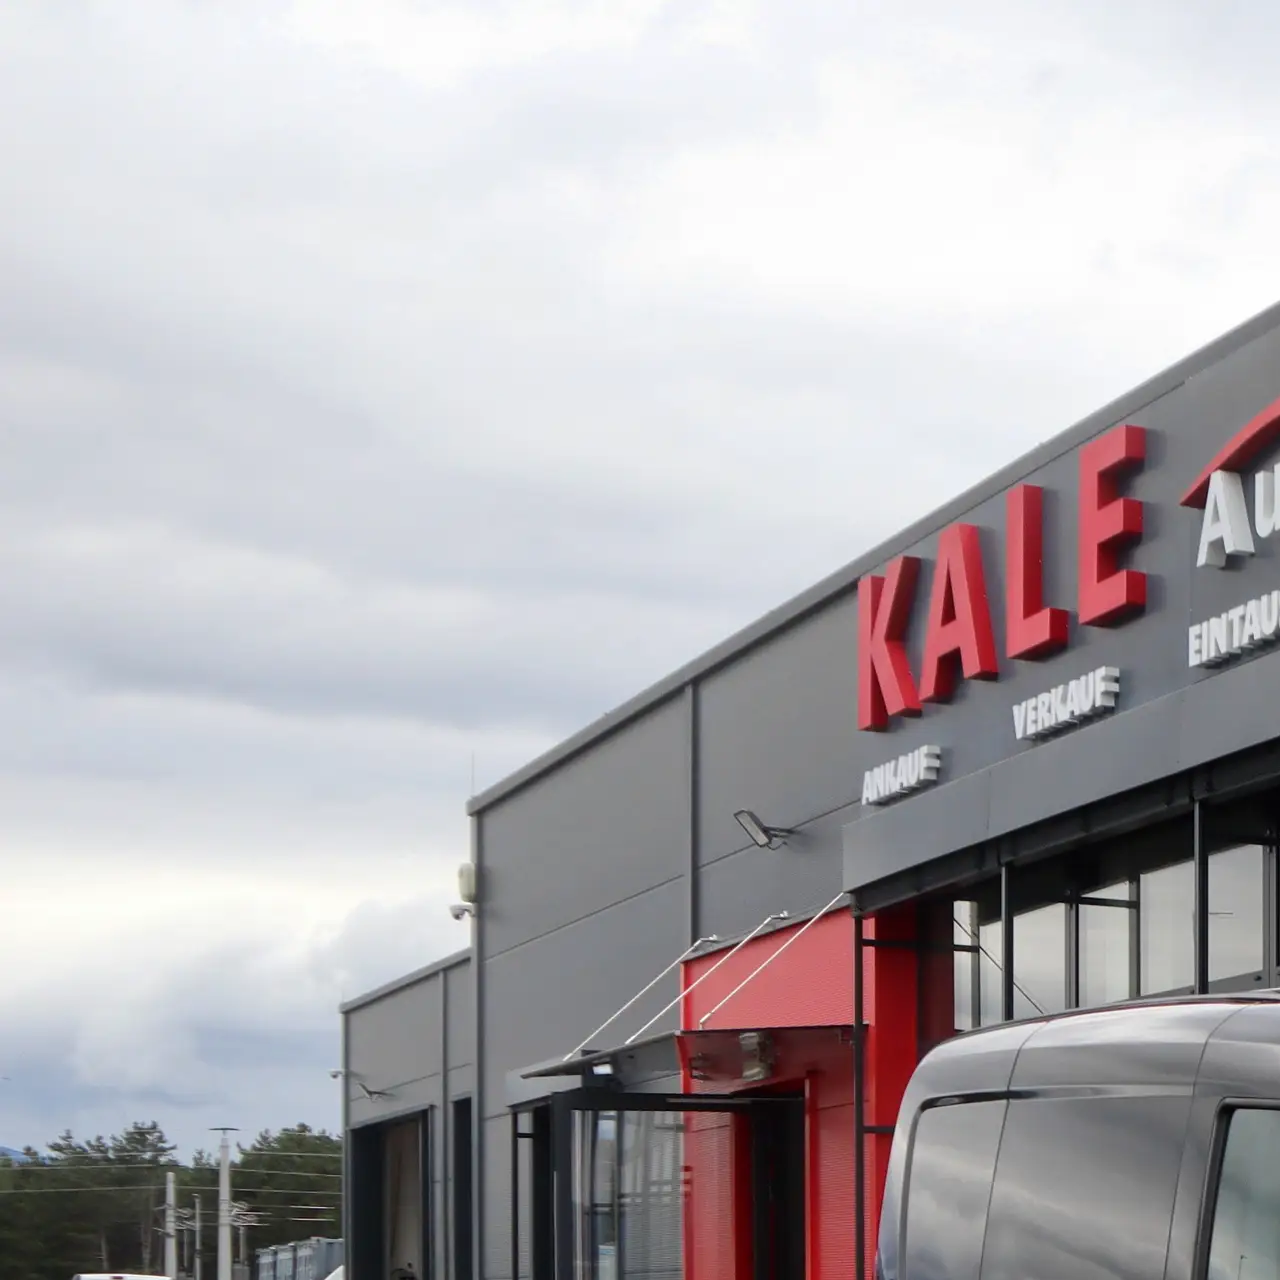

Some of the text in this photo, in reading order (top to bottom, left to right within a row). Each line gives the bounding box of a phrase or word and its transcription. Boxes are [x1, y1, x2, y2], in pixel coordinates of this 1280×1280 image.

[858, 424, 1147, 732] KALE
[1013, 666, 1120, 740] VERKAUF
[862, 745, 941, 805] ANKAUF
